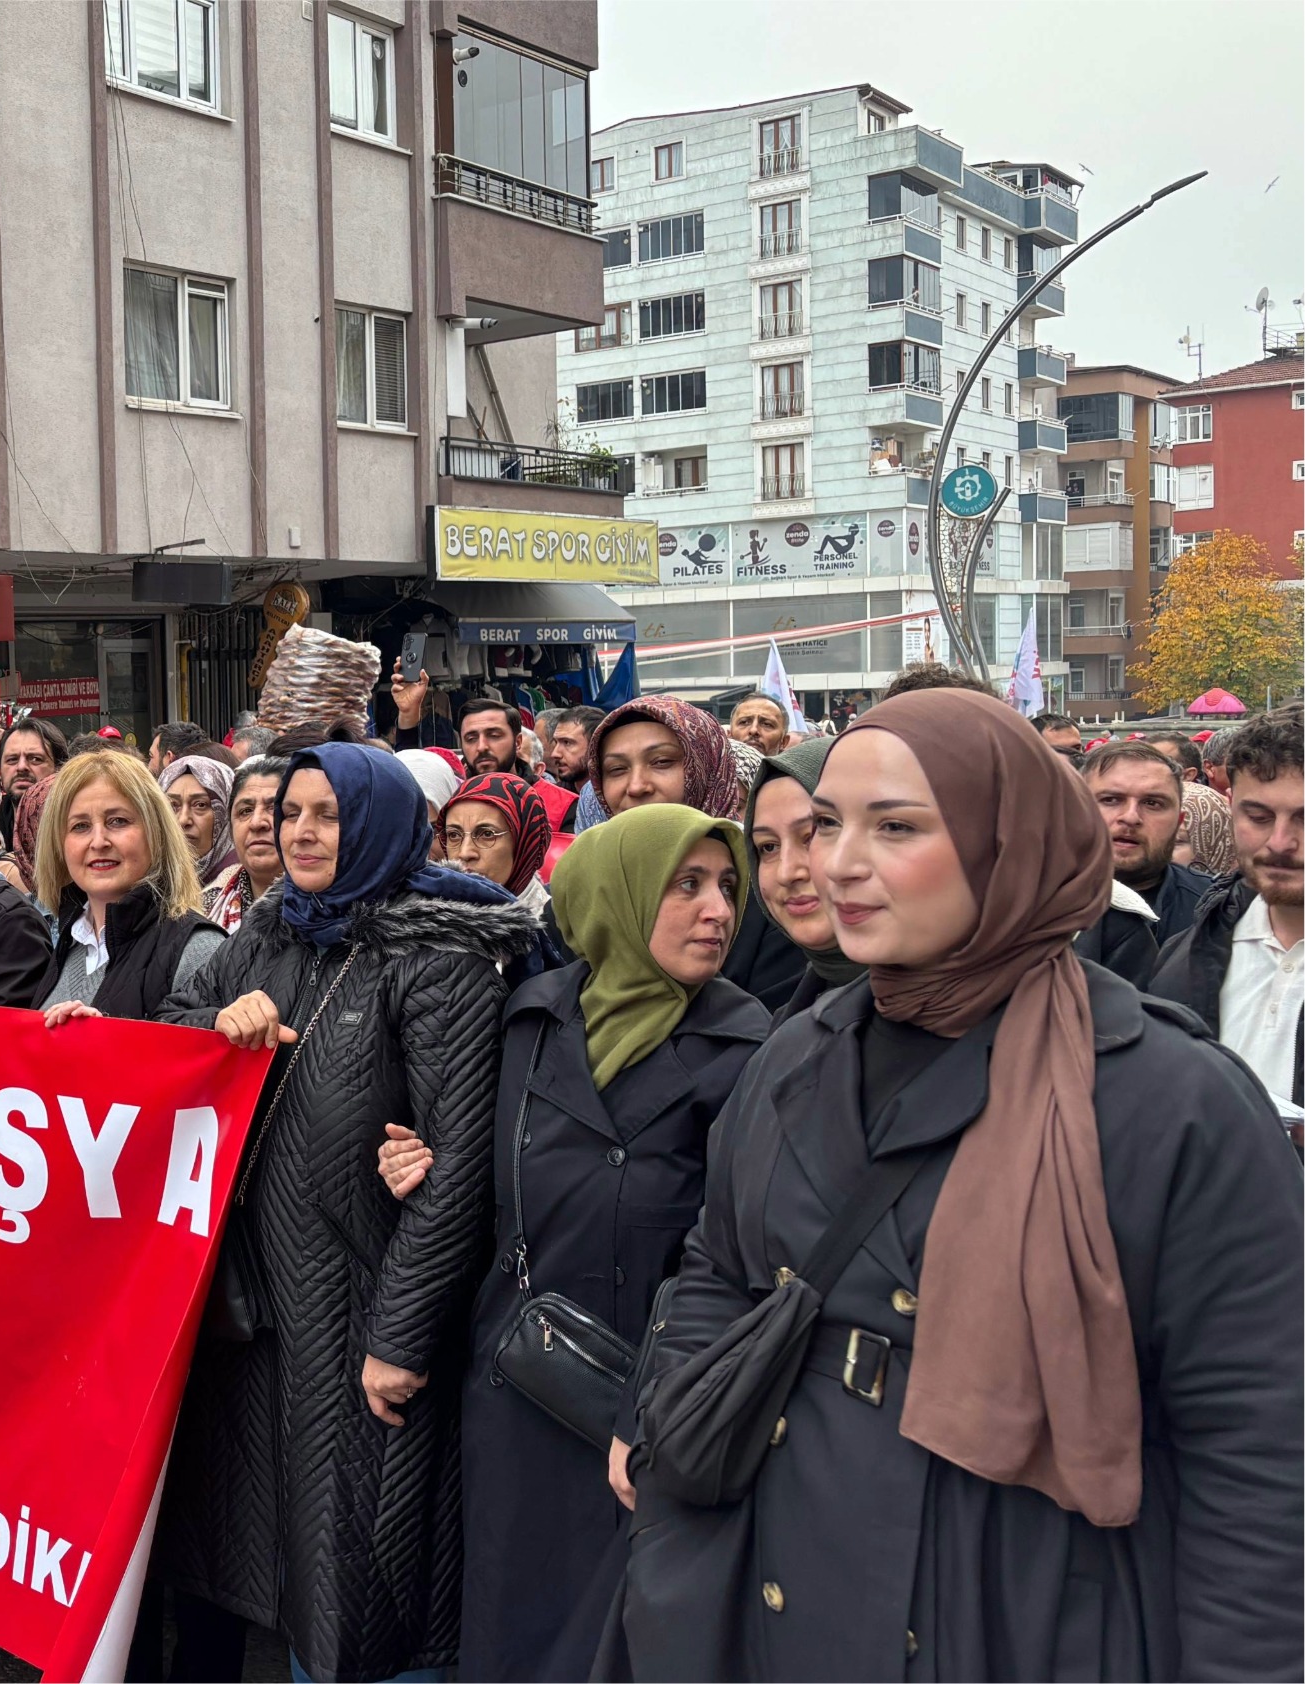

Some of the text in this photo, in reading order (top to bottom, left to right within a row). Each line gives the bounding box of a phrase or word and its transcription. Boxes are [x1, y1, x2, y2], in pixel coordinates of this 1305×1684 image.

[445, 524, 651, 565] BERAT SPOR GİYİM
[813, 552, 858, 562] PERSONEL
[673, 564, 724, 577] PILATES
[737, 564, 787, 577] FITNESS
[813, 562, 855, 571] TRAINING
[479, 624, 618, 642] BERAT SPOR GİYİM
